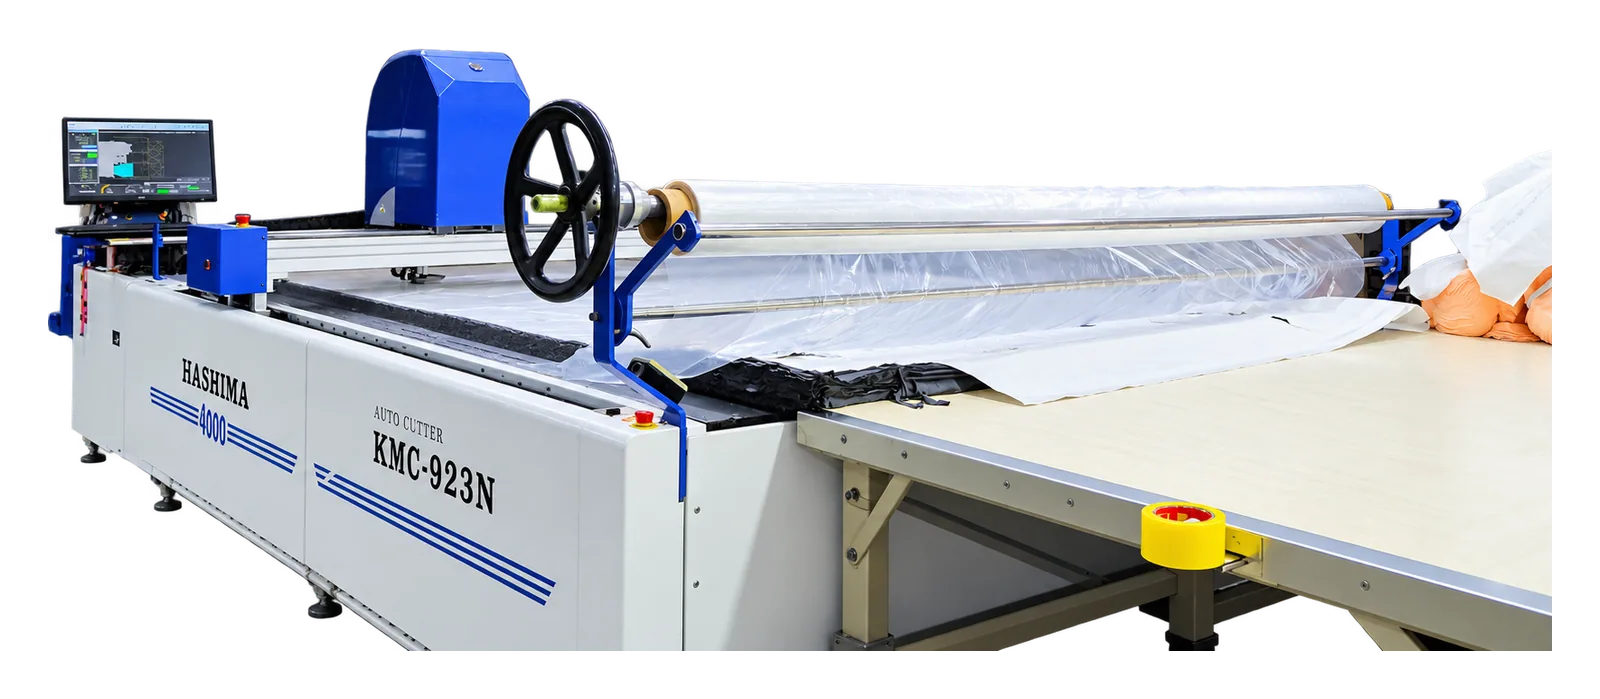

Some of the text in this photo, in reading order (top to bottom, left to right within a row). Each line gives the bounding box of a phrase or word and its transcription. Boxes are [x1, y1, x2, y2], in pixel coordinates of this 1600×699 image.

[182, 358, 249, 410] HASHIMA
[199, 403, 226, 446] 4000
[373, 405, 443, 444] AUTO CUTTER
[373, 430, 495, 514] KMC-923N
